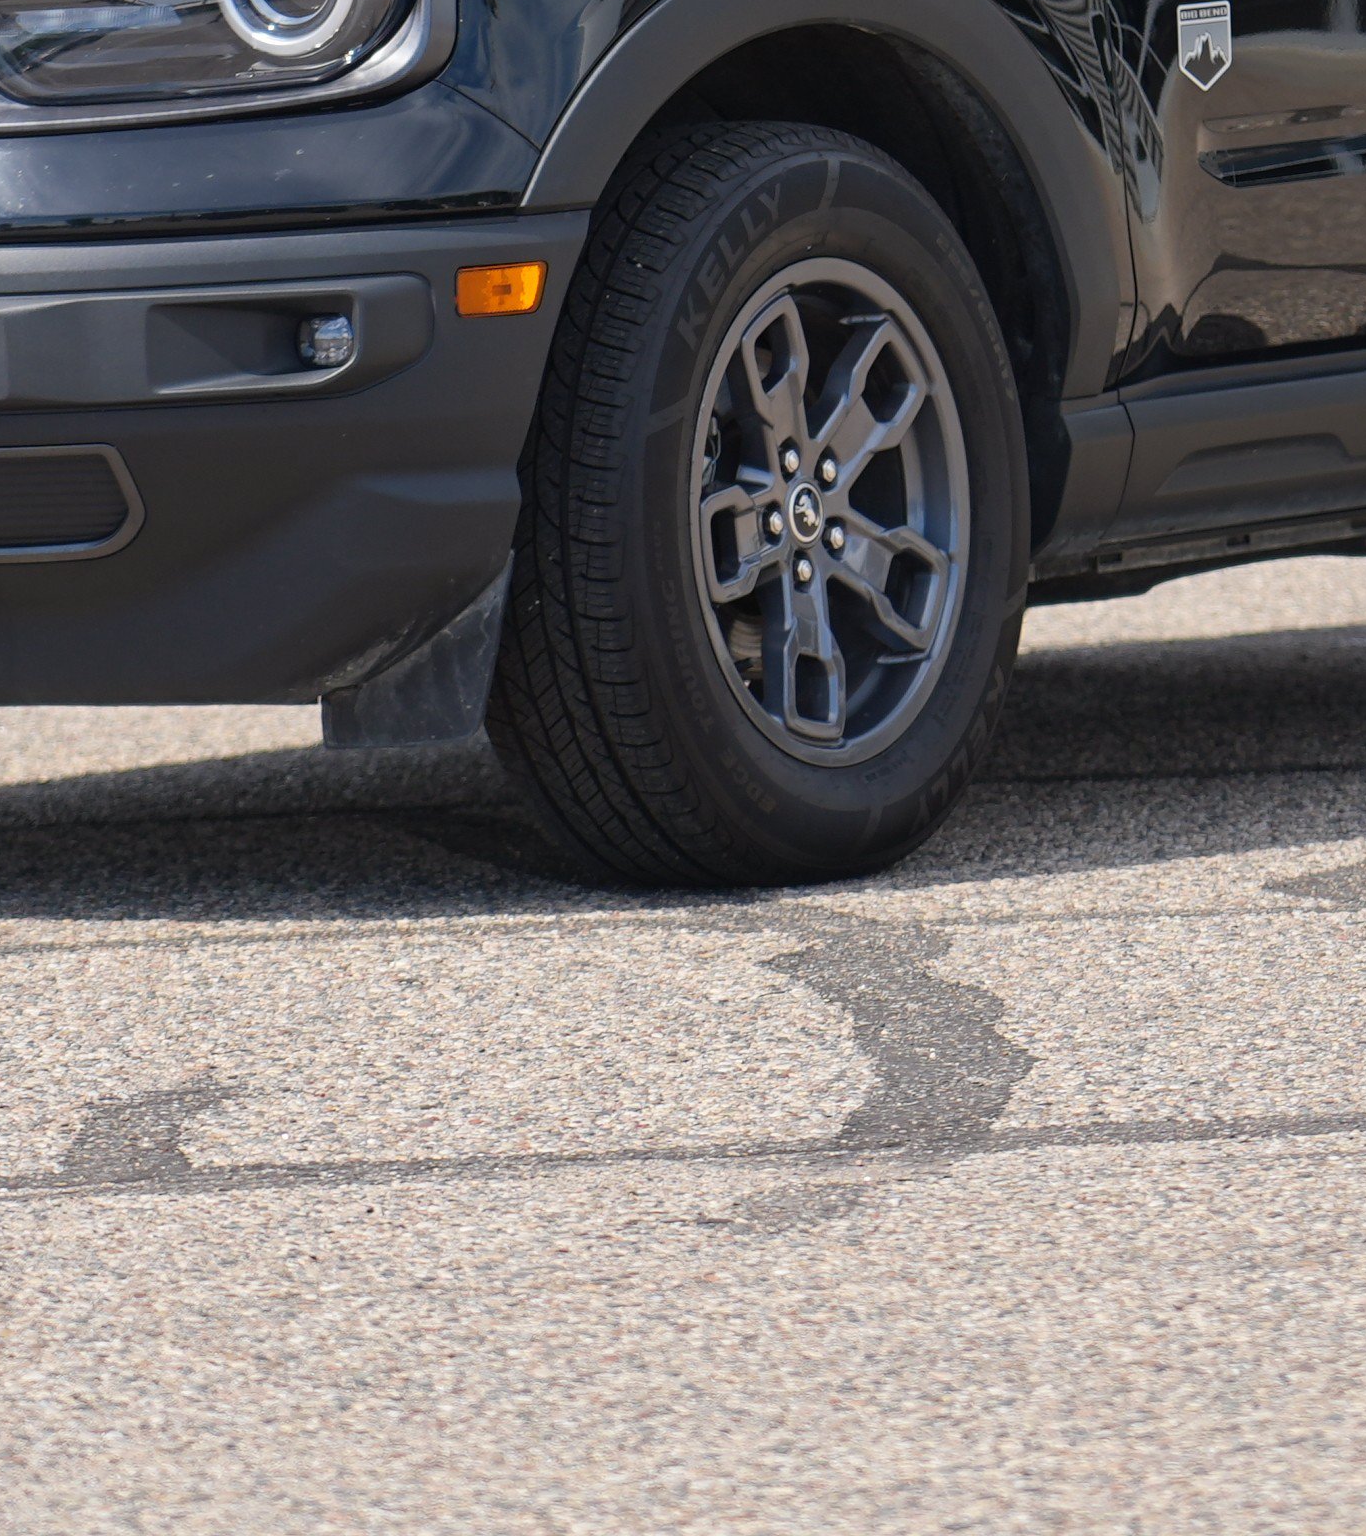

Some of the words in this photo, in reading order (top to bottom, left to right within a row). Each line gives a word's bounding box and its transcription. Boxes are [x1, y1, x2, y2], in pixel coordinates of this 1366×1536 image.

[1181, 10, 1198, 20] BIG
[1199, 7, 1228, 18] BEND
[677, 183, 781, 351] KELLY
